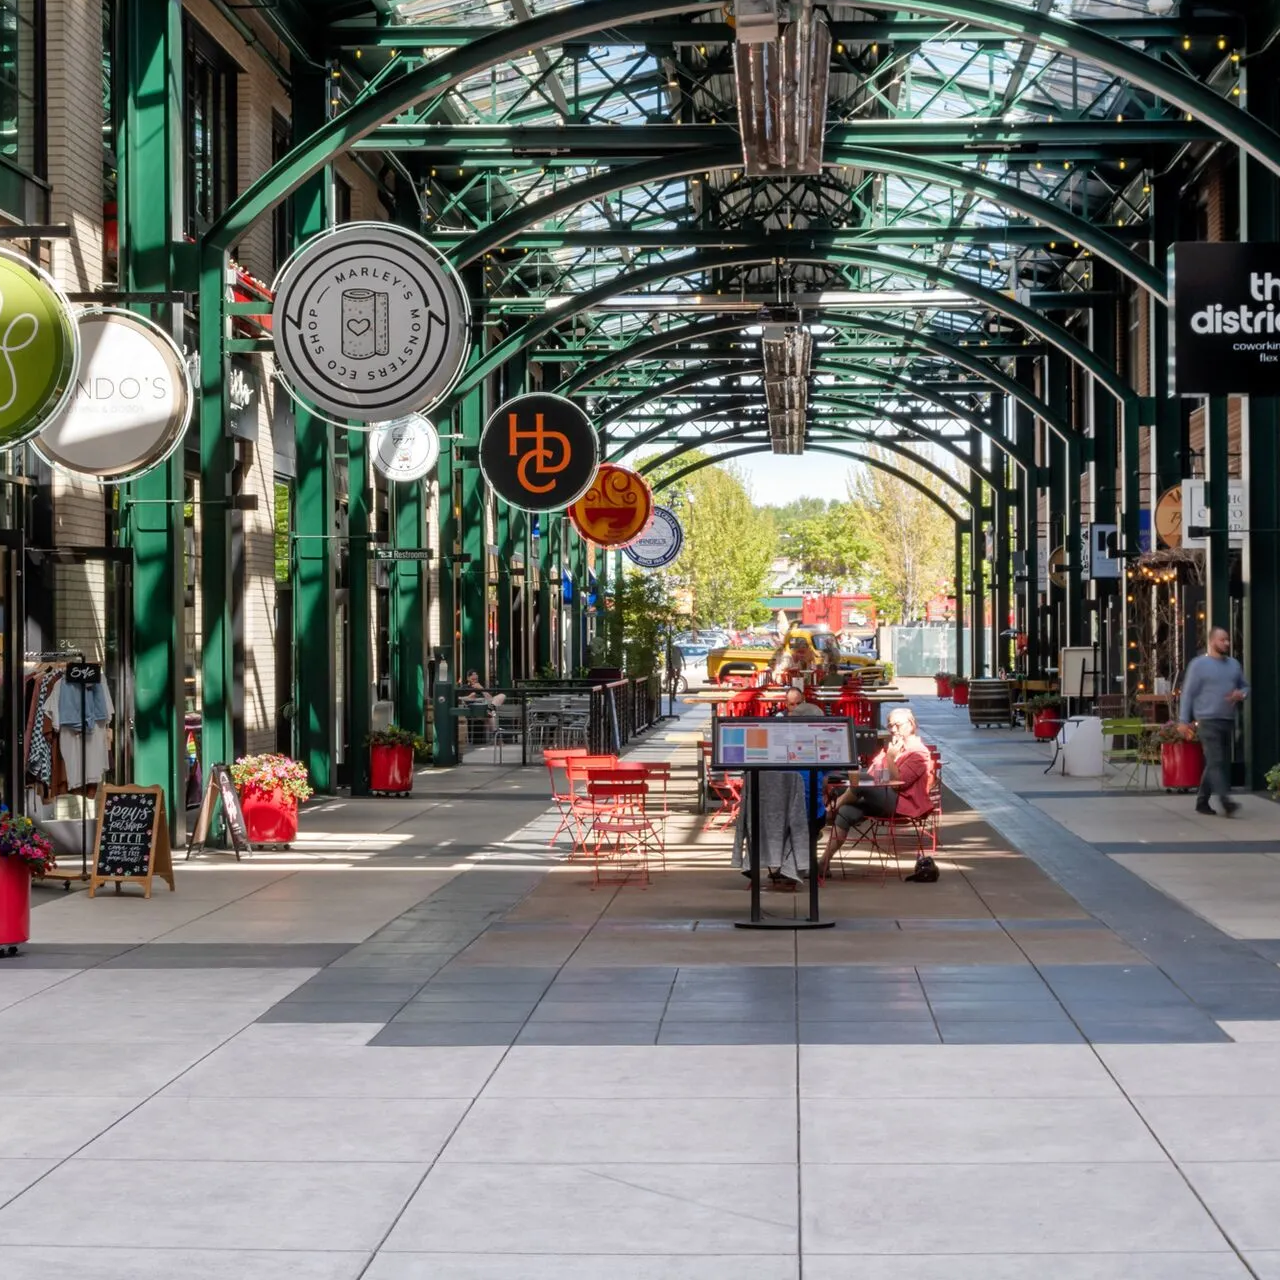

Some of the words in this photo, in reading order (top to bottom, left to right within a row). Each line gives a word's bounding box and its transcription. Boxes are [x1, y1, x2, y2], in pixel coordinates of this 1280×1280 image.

[333, 266, 414, 301] MARLEY'S
[308, 308, 325, 355] SHOP
[367, 308, 421, 381] MONSTERS
[1259, 352, 1278, 362] flex
[327, 359, 357, 380] ECO
[70, 376, 166, 400] NDO'S
[393, 550, 428, 559] Restrooms
